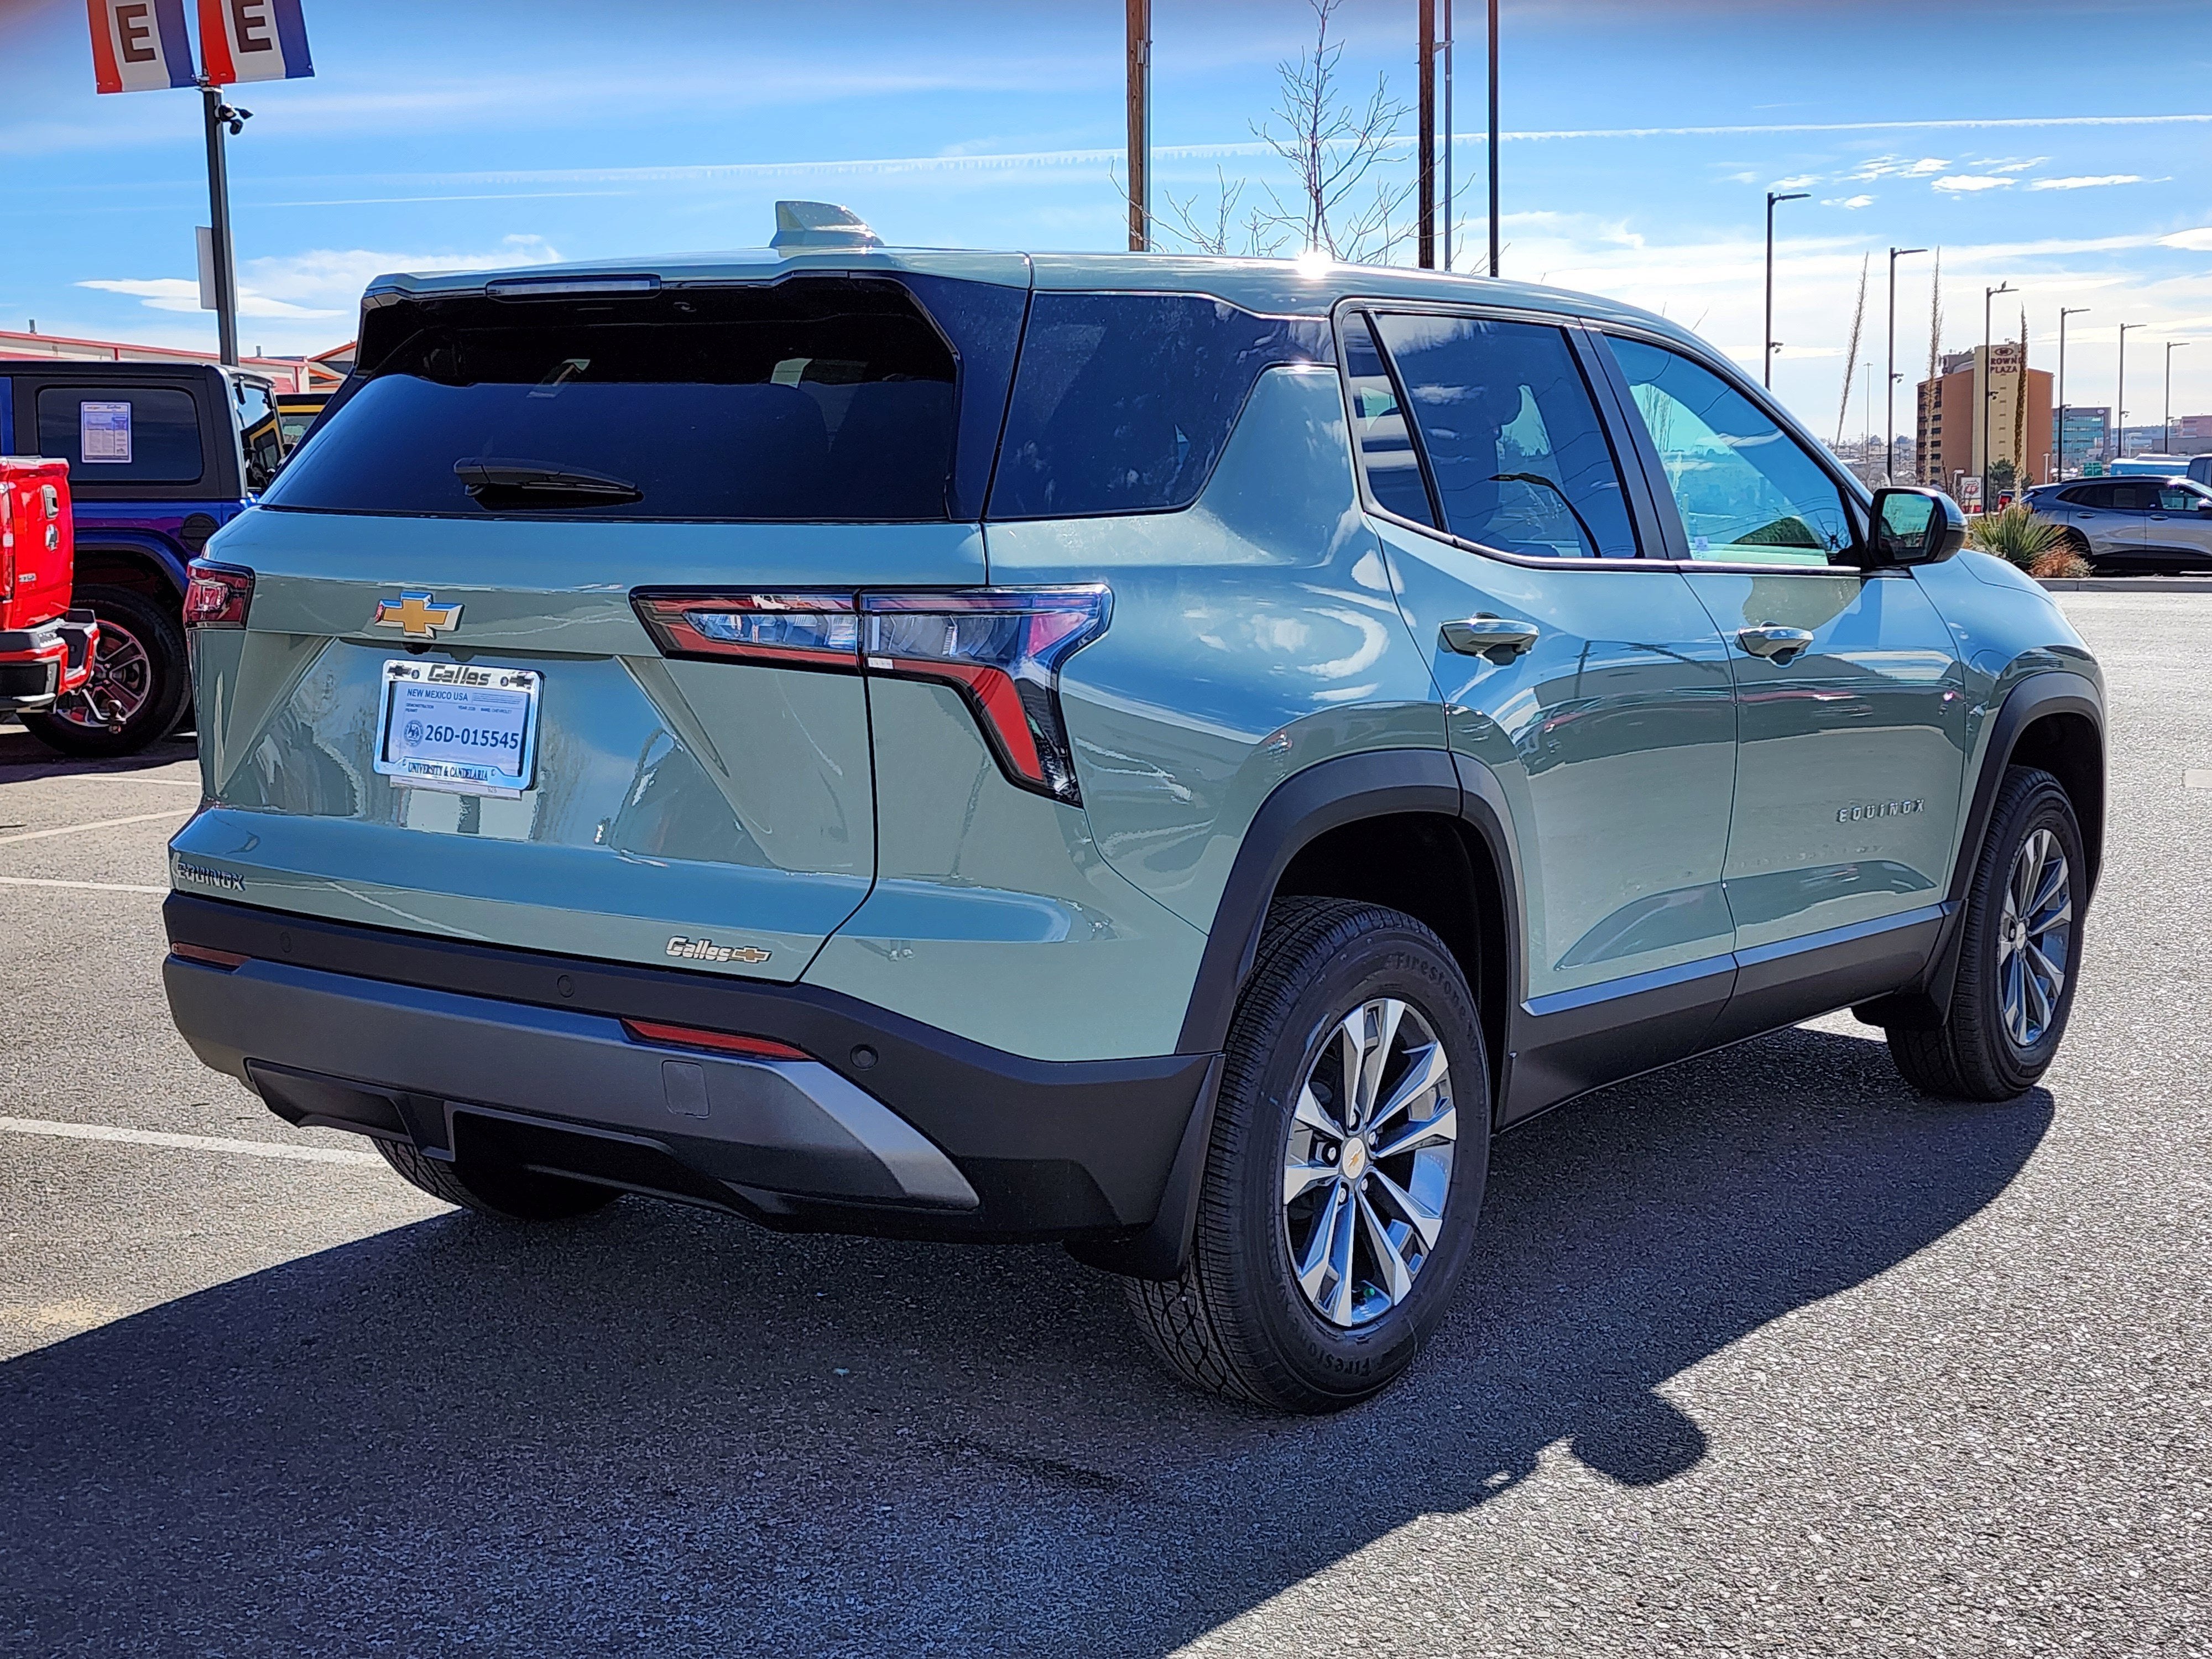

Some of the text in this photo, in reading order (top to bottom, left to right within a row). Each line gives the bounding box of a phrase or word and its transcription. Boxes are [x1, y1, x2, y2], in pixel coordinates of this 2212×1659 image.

[427, 664, 492, 686] Galles
[407, 688, 424, 697] NEW
[425, 690, 452, 700] MEXICO
[453, 692, 468, 701] USA
[425, 725, 519, 749] 26D-015545
[408, 762, 488, 781] UNIVERSITY & CANDELARIA
[1837, 799, 1924, 823] EQUINOX
[177, 862, 245, 891] EQUINOX
[666, 936, 733, 962] Galles
[1393, 952, 1465, 1019] Firestone
